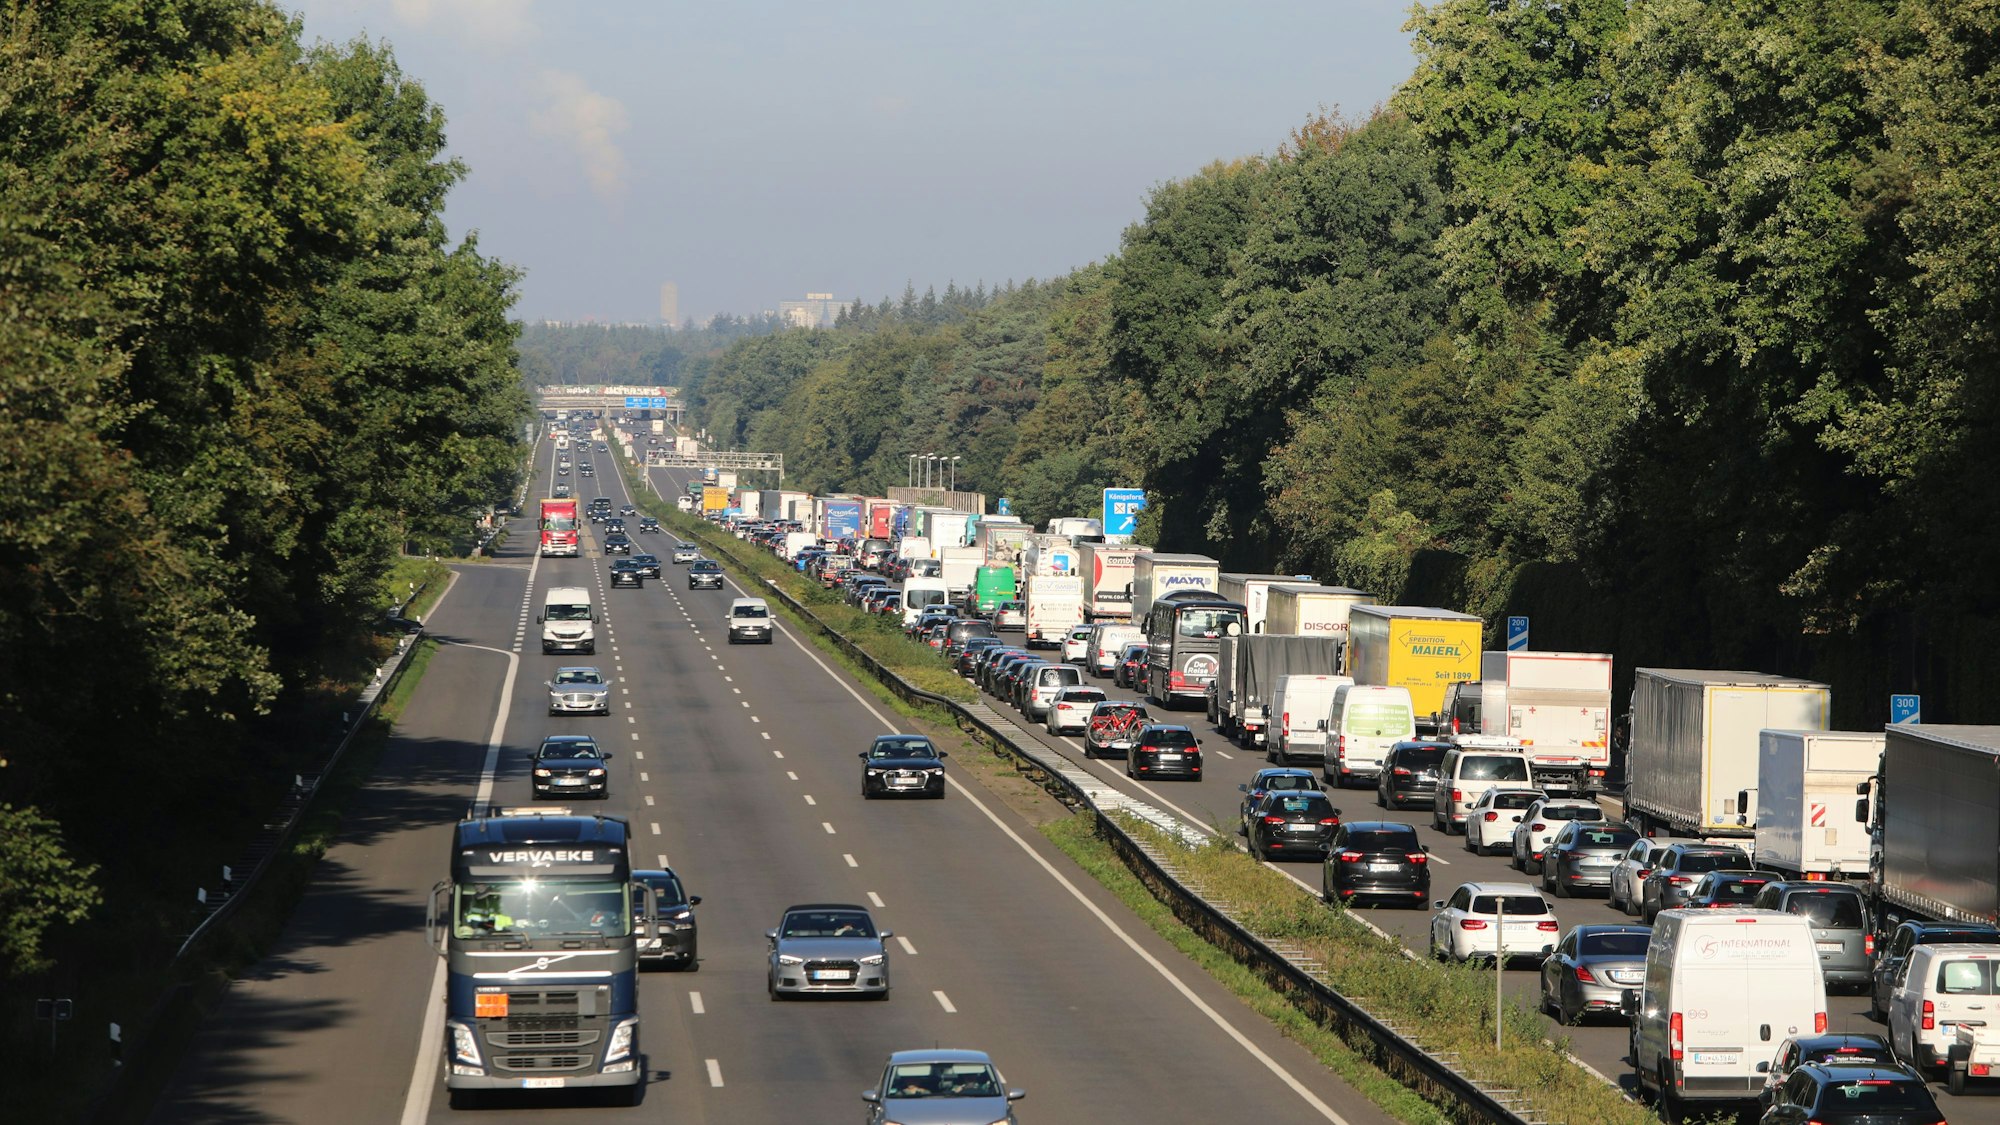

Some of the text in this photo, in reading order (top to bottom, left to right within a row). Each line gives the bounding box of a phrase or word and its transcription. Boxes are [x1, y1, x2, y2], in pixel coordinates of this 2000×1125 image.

[1165, 576, 1206, 588] MAYR
[1411, 645, 1462, 656] MAIERL
[1435, 671, 1471, 680] Seit 1899
[1896, 698, 1915, 708] 300
[489, 850, 594, 862] VERVAEKE
[1721, 939, 1791, 948] INTERNATIONAL
